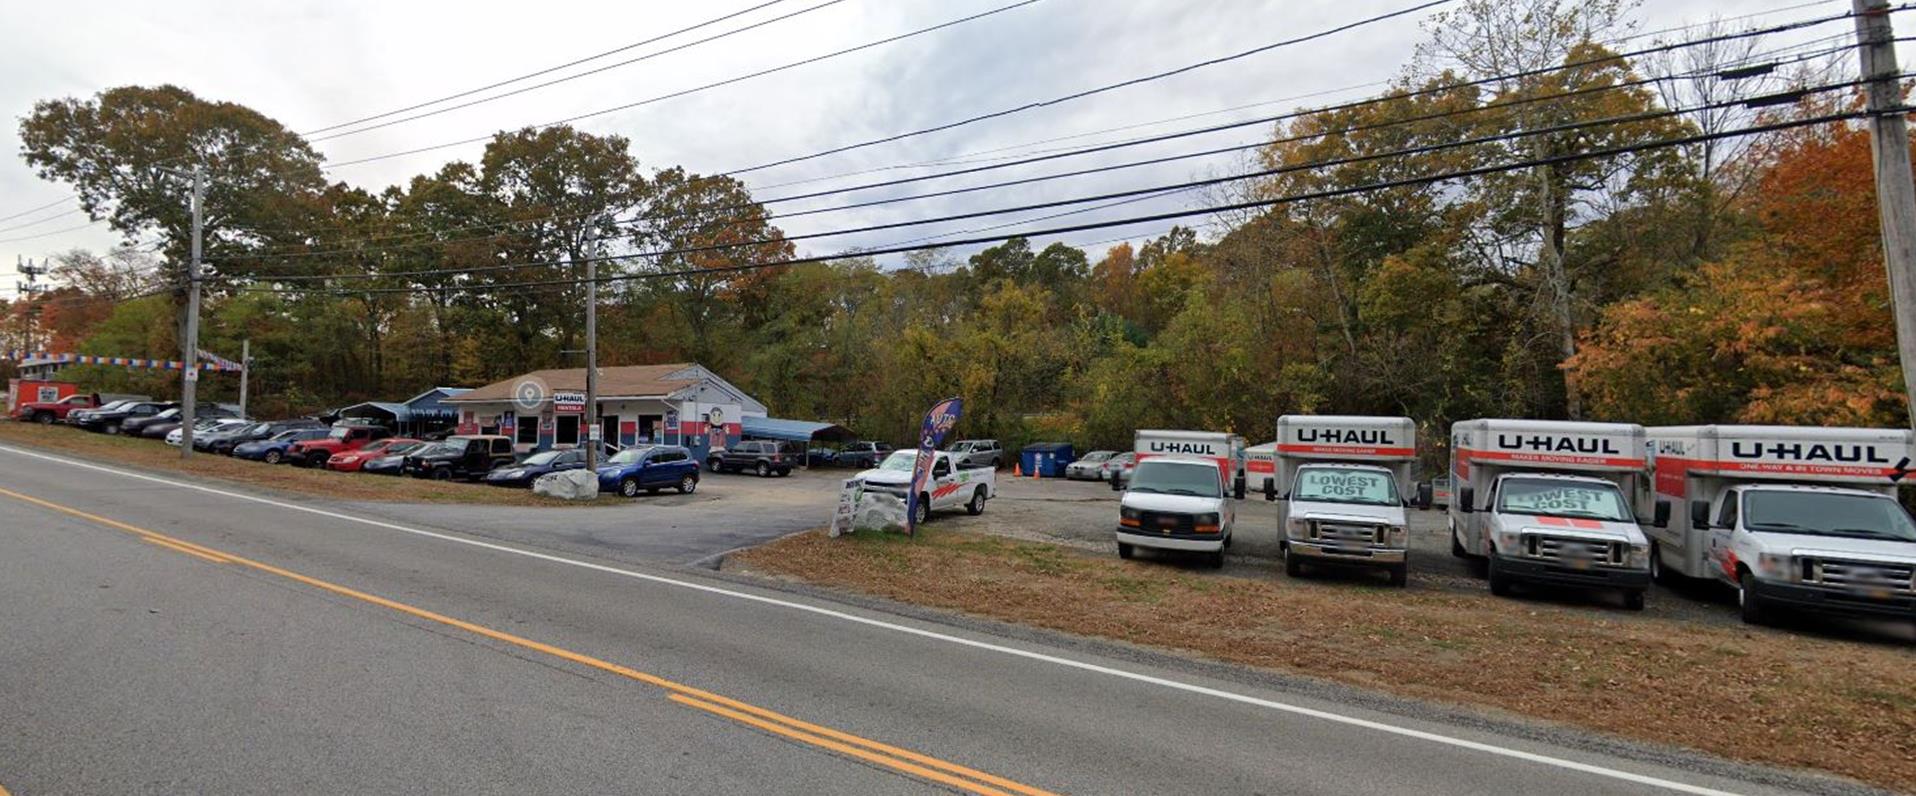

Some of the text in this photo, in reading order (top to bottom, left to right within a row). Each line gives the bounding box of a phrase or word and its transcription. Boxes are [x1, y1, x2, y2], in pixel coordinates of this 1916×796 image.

[1298, 428, 1395, 445] U-HAUL
[1151, 441, 1216, 455] U-HAUL
[1499, 434, 1620, 454] U-HAUL
[1511, 453, 1607, 465] MAKES MOVING EASIER
[1732, 442, 1889, 463] U-HAUL
[1843, 467, 1882, 475] MOVES
[1310, 474, 1379, 488] LOWEST
[1322, 485, 1366, 496] COST
[1535, 499, 1588, 510] COST
